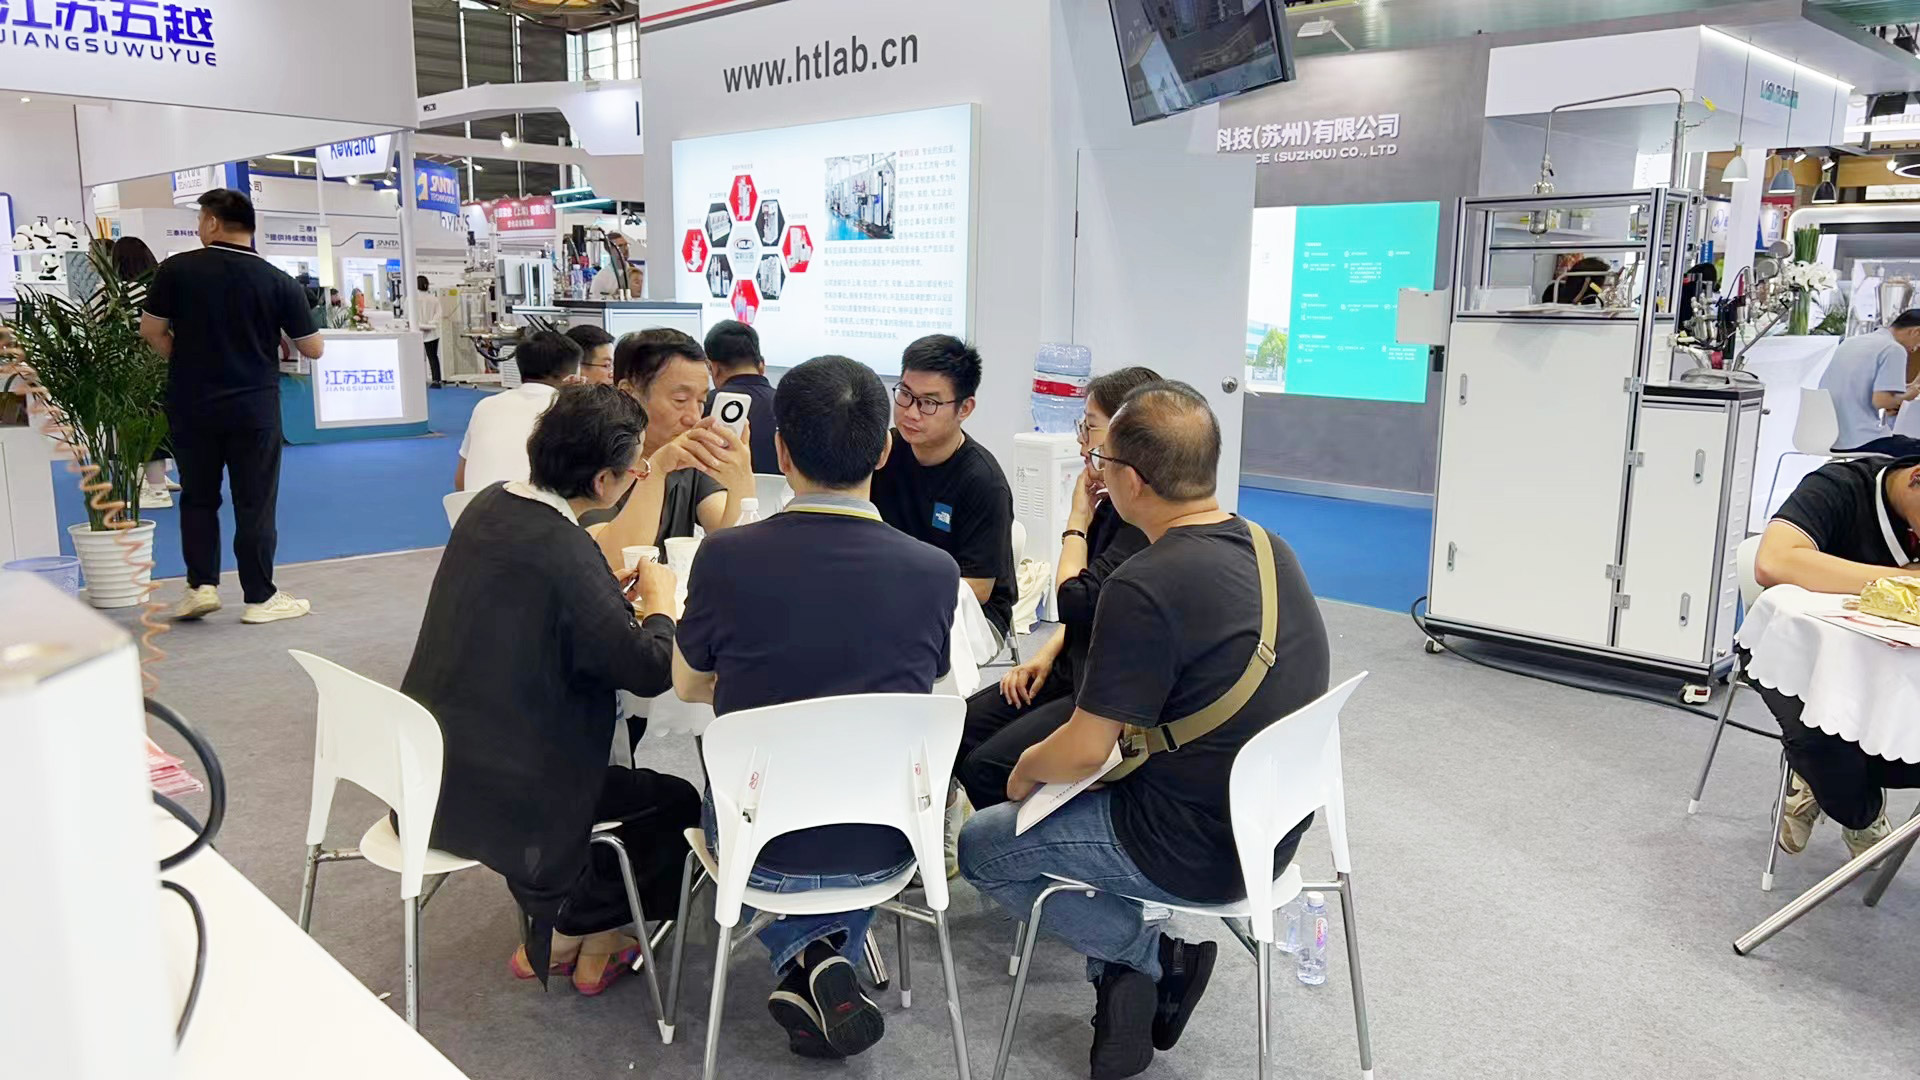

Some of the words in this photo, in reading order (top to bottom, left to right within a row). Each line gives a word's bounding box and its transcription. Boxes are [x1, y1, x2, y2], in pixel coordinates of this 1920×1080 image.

[0, 28, 217, 67] JIANGSUWUYUE
[723, 33, 918, 93] www.htlab.cn
[1274, 148, 1337, 164] (SUZHOU)
[1370, 143, 1398, 157] LTD
[325, 369, 395, 385] 江苏五越
